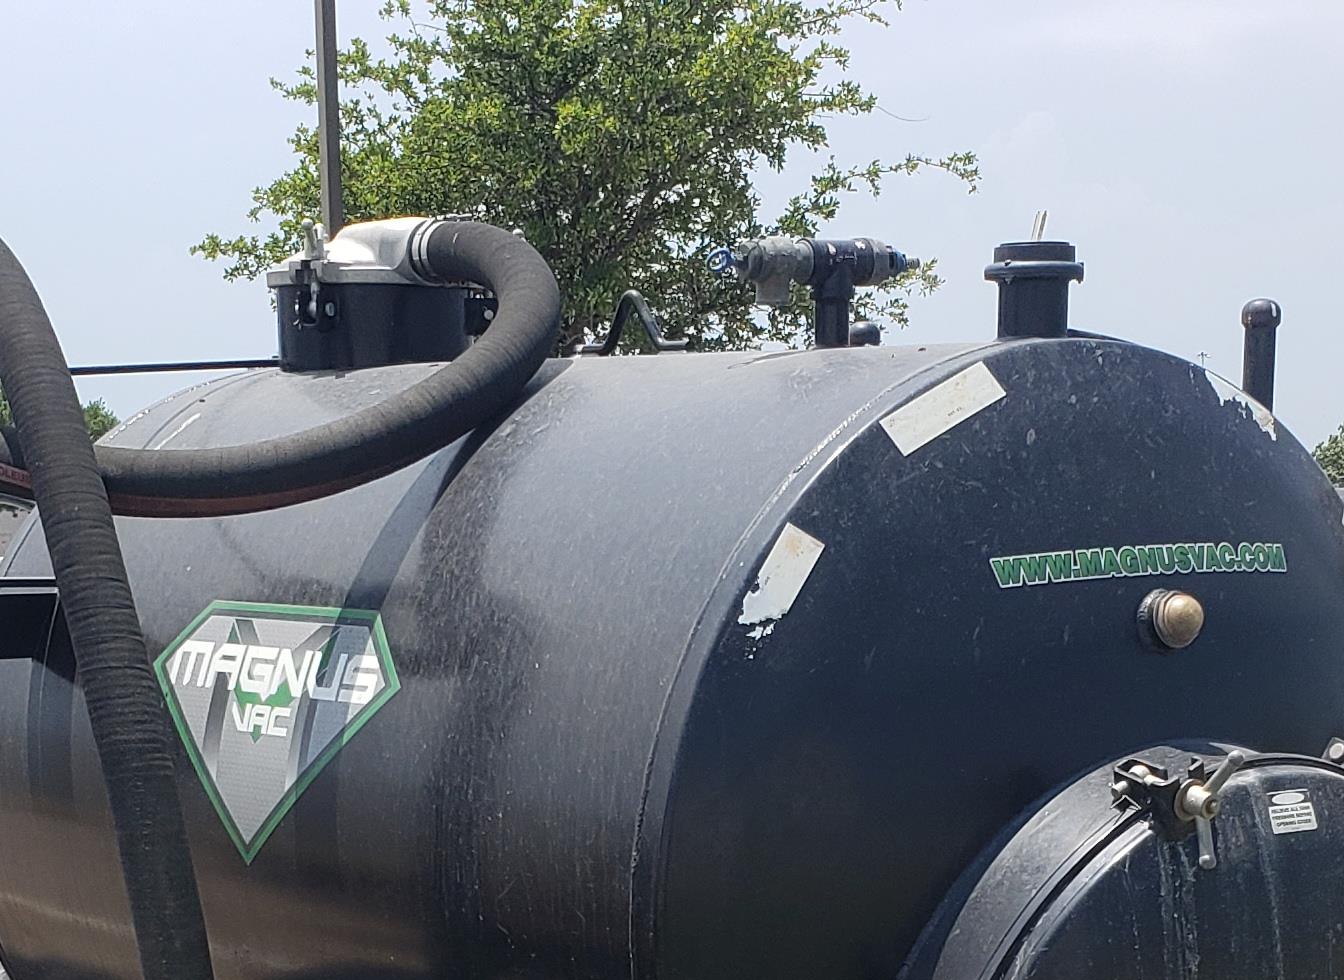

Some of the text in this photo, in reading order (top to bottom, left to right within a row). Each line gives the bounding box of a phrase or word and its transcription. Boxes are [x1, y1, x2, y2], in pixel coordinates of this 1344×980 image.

[990, 542, 1287, 588] WWW.MAGNUSVAC.COM
[170, 640, 378, 704] MAGNUS
[232, 701, 292, 737] VAC
